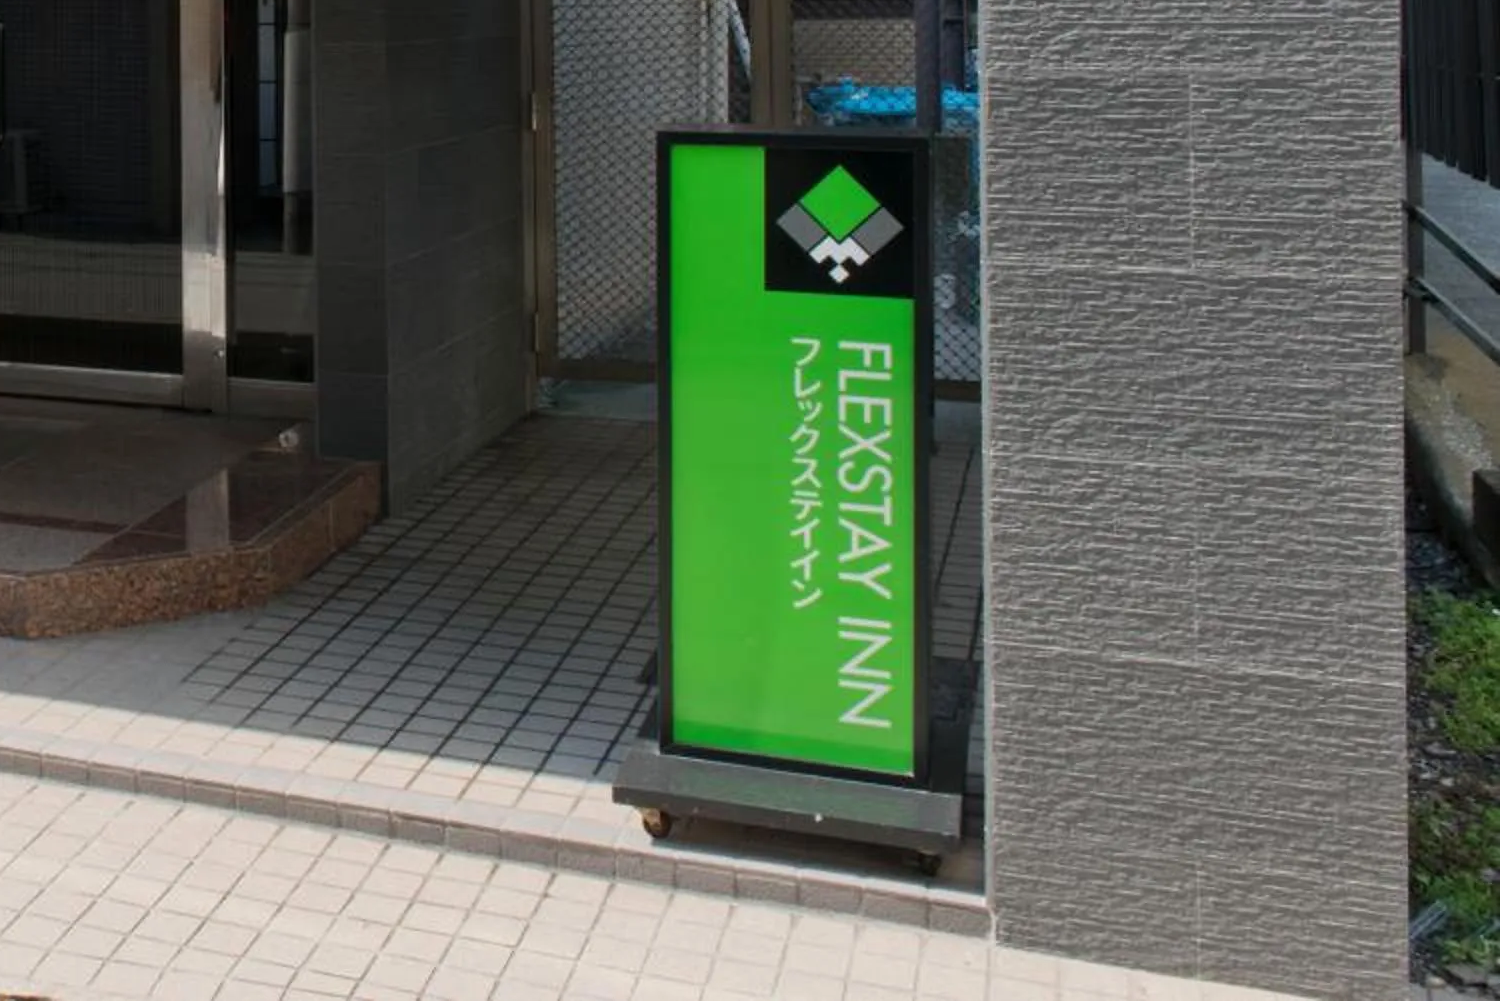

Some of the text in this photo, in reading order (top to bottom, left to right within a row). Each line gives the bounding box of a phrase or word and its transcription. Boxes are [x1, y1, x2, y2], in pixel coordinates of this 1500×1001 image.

[790, 337, 823, 609] フレックステイイン
[837, 340, 893, 729] FLEXSTAY INN
